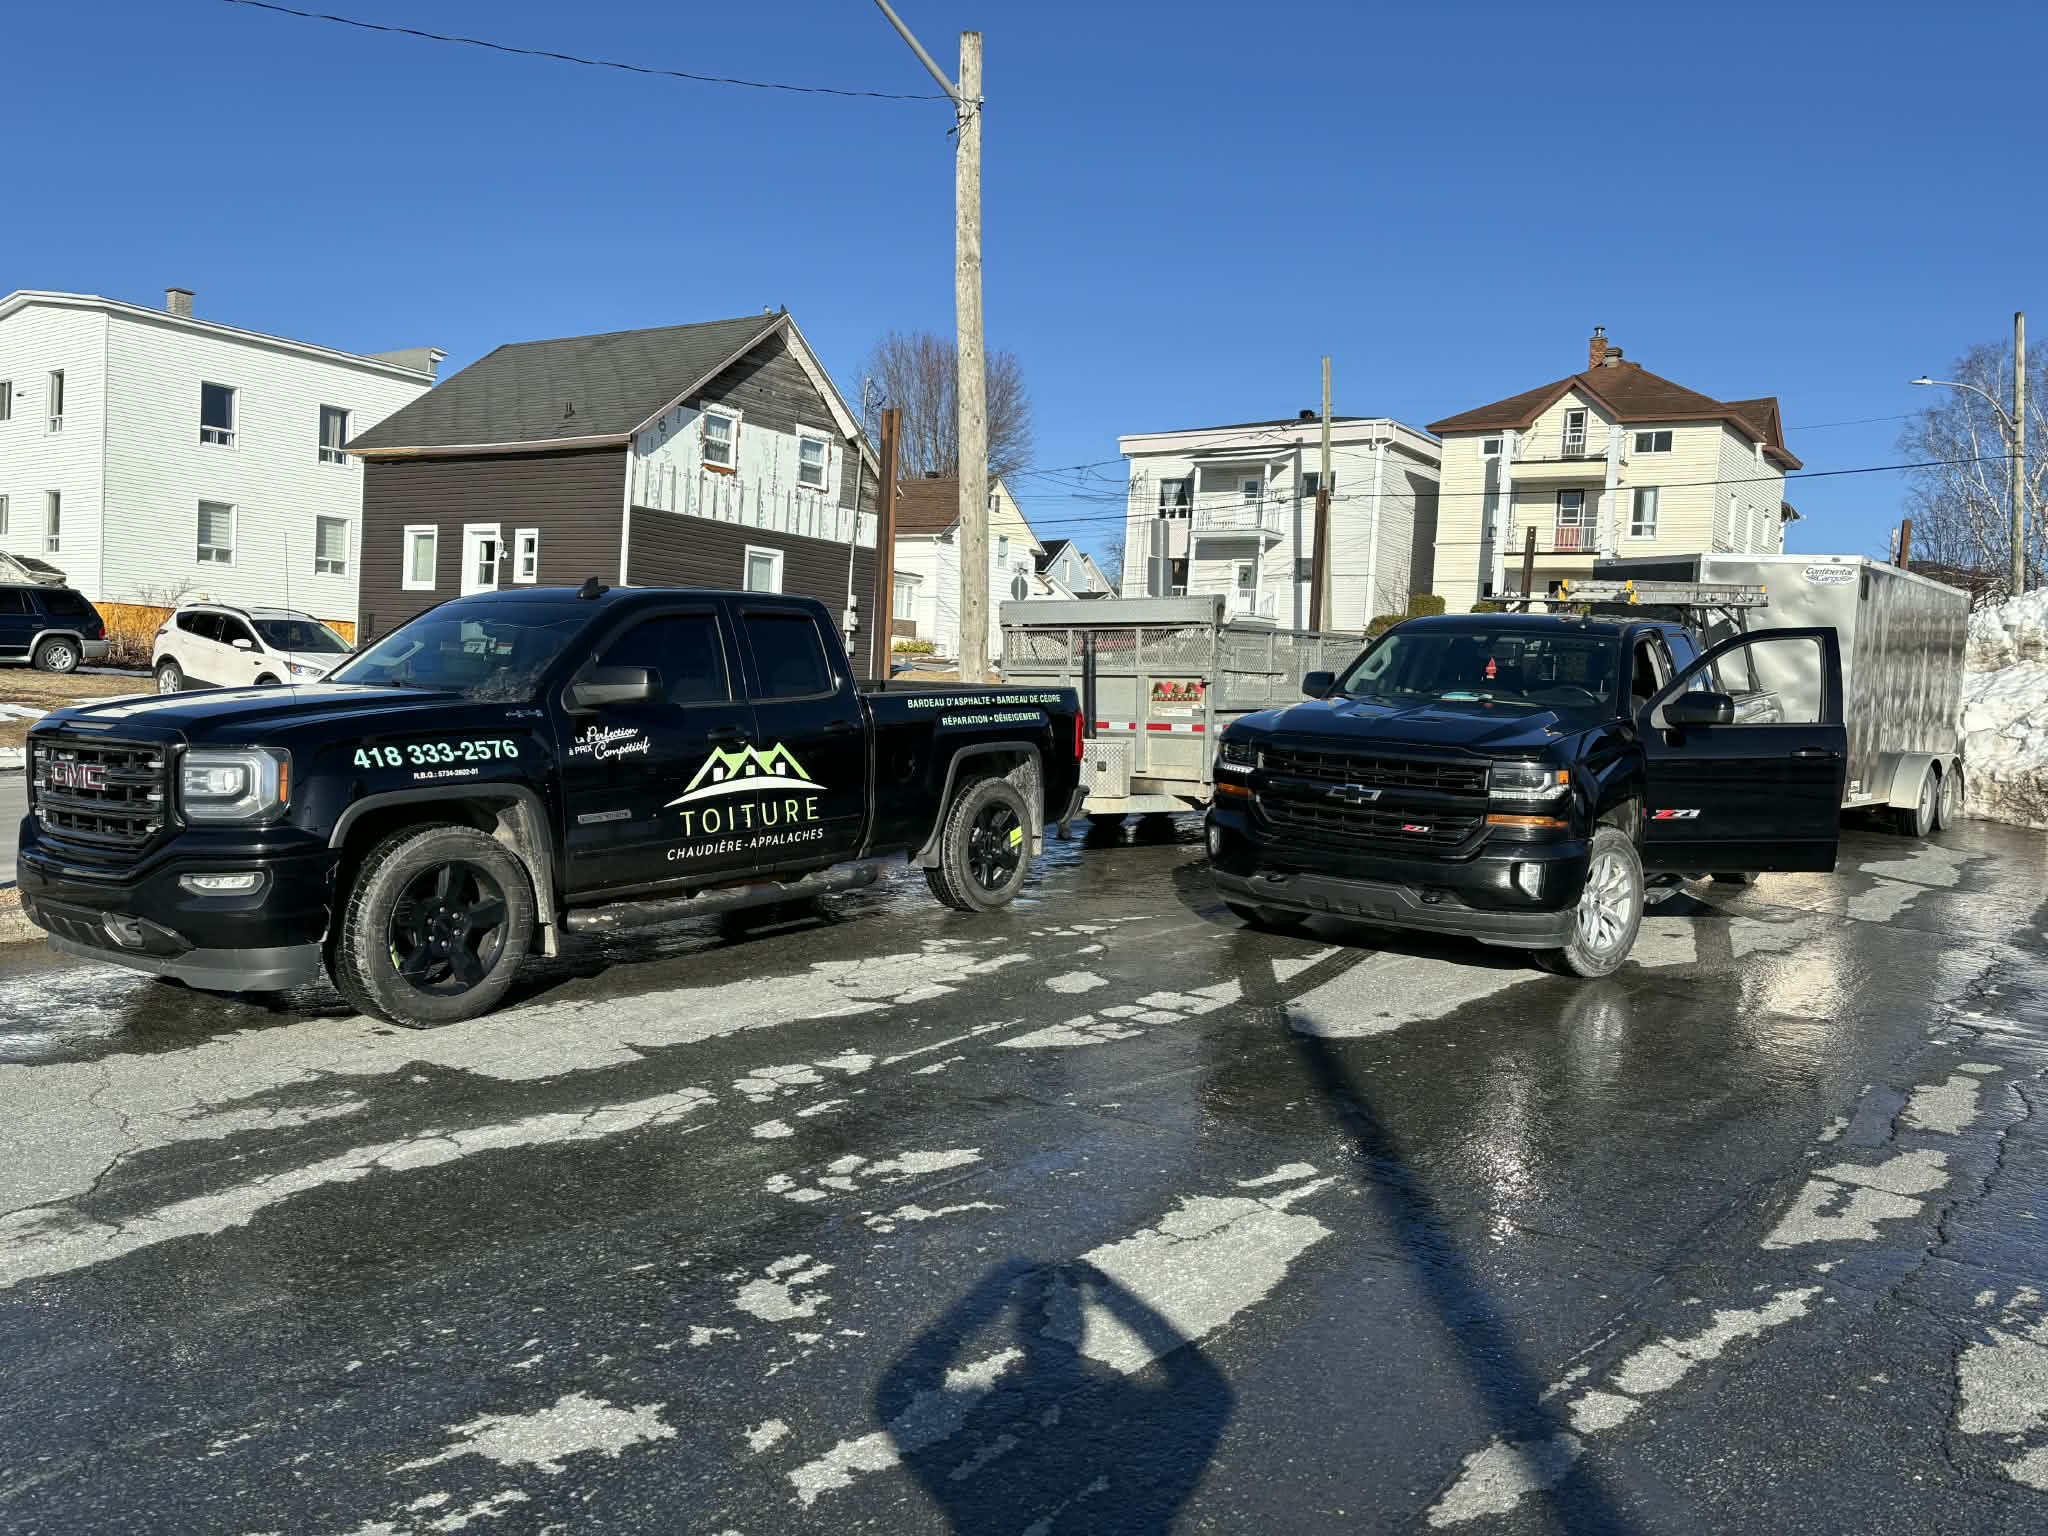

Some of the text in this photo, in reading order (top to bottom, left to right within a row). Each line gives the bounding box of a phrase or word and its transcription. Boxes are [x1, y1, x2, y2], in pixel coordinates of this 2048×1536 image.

[1805, 567, 1855, 576] Continental
[907, 698, 945, 709] BARDEAU
[947, 696, 992, 707] D'ASPHALTE
[997, 695, 1028, 704] BARDEAU
[1030, 694, 1038, 703] DE
[942, 711, 1041, 726] RÉPARATION DÉNEIGEMENT
[586, 725, 639, 744] Perfection
[353, 739, 519, 769] 418 333-2576
[575, 745, 593, 755] PRIX
[595, 735, 651, 761] Compétitif
[52, 761, 106, 791] GMC
[679, 796, 820, 837] TOITURE
[1651, 809, 1701, 820] Z71
[667, 828, 824, 861] CHAUDIÈRE-APPALACHES
